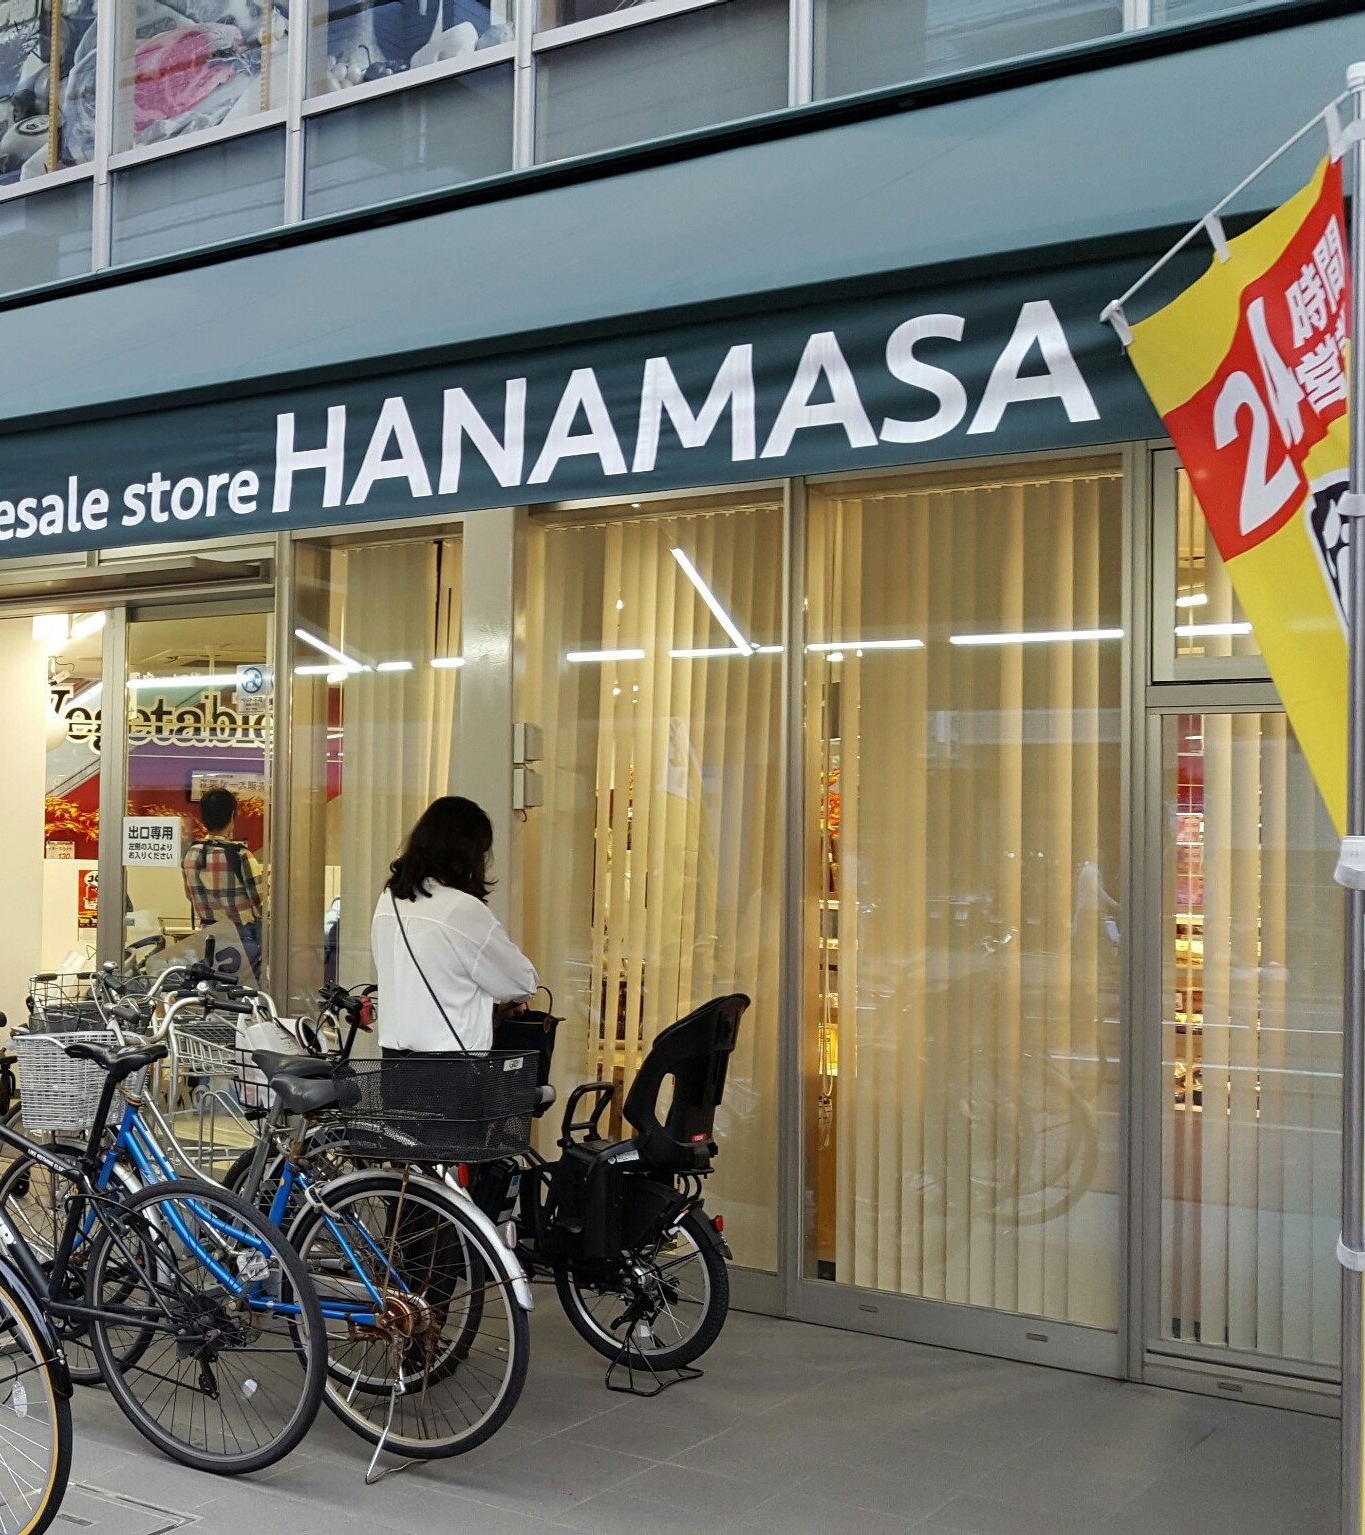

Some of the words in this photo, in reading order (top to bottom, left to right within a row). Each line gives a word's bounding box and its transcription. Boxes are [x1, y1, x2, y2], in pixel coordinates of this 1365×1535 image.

[1285, 214, 1346, 349] 時間
[121, 470, 259, 527] store
[271, 299, 1100, 514] HANAMASA
[1213, 297, 1305, 536] 24
[128, 826, 173, 840] 出口専用
[128, 843, 173, 851] 左側の入口より
[128, 852, 173, 860] お入りください
